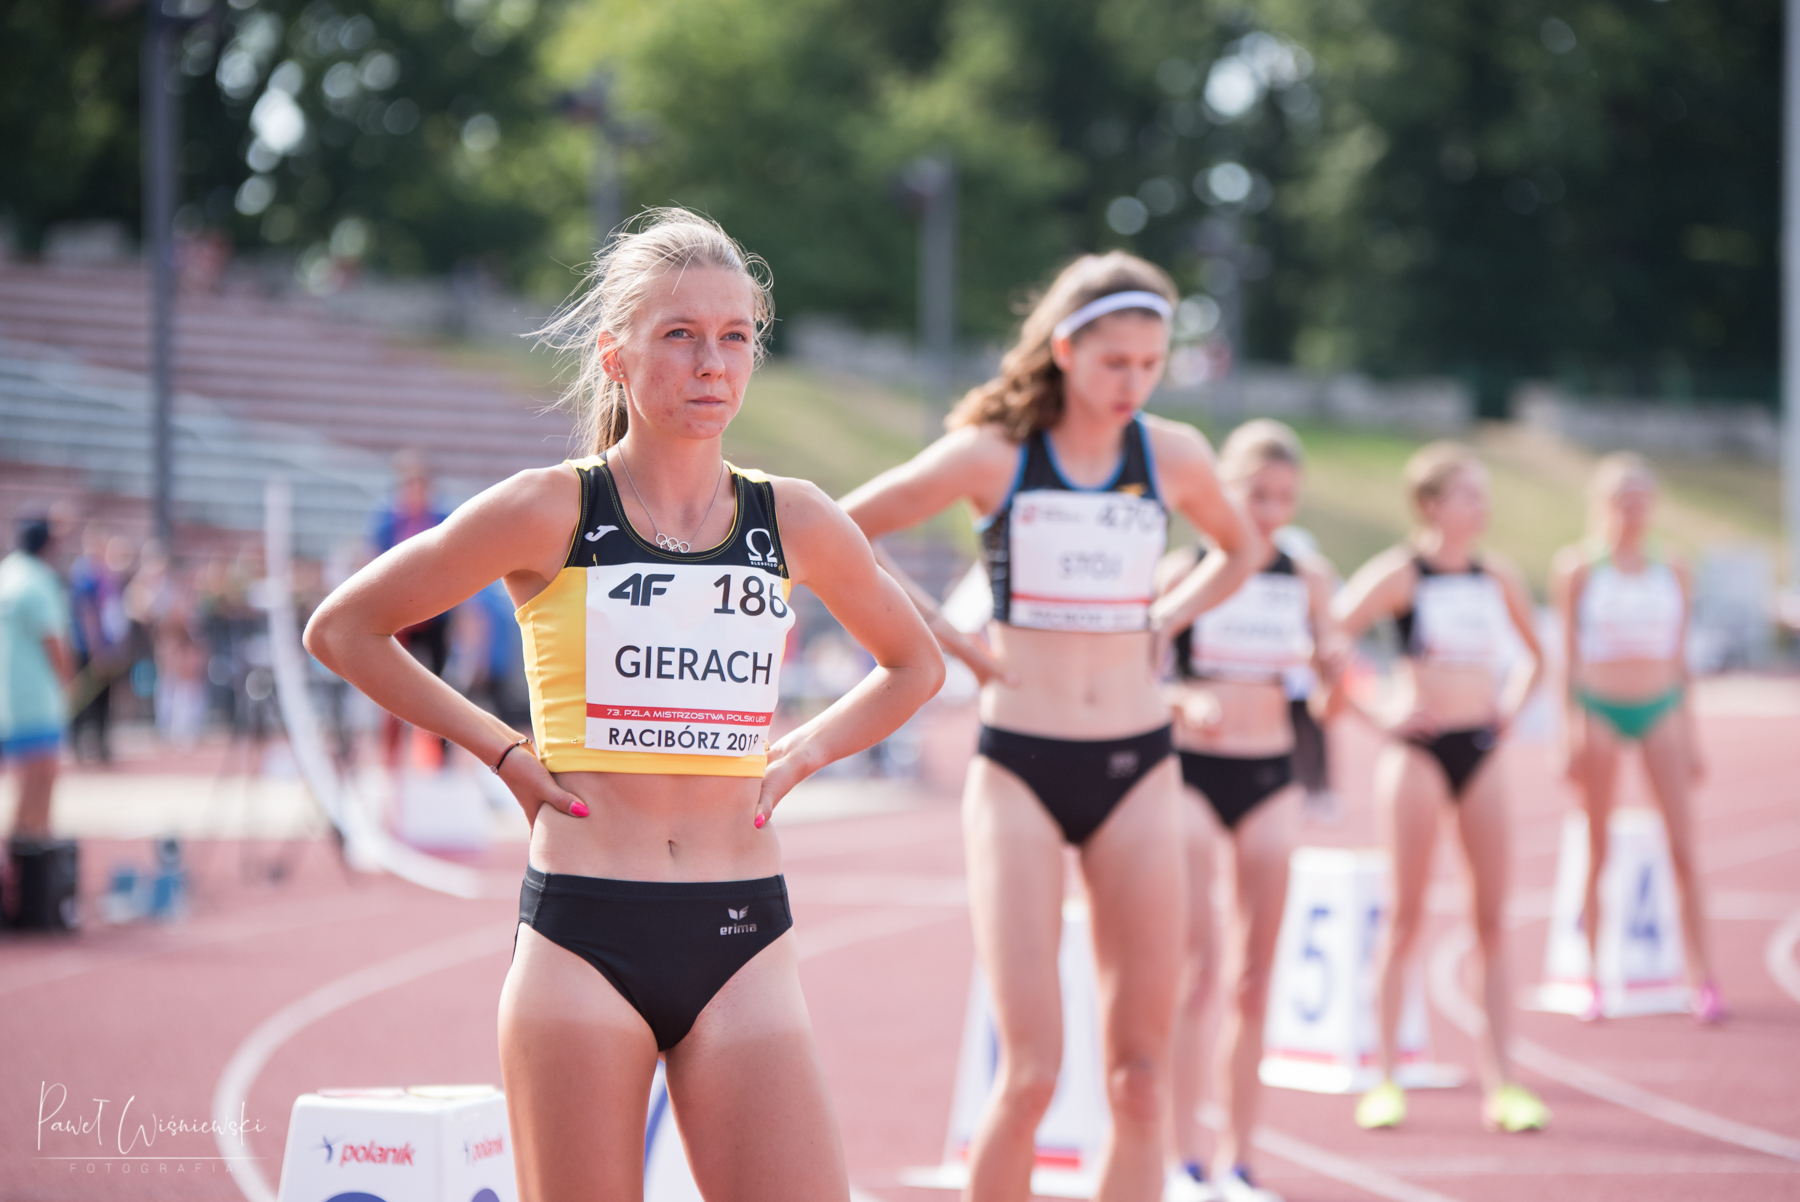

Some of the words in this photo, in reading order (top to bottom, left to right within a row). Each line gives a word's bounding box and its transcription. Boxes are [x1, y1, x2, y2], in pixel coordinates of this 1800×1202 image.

[608, 573, 675, 606] 4F
[713, 574, 788, 618] 186
[615, 645, 773, 685] GIERACH
[606, 708, 622, 717] 73.
[624, 709, 651, 718] PZLA
[652, 710, 725, 721] MISTRZOSTWA
[726, 714, 755, 723] POLSKI
[608, 725, 720, 750] RACIBÓRZ
[726, 732, 759, 752] 2019
[719, 923, 757, 936] erima
[1295, 905, 1334, 1022] 5
[339, 1140, 416, 1168] polanik
